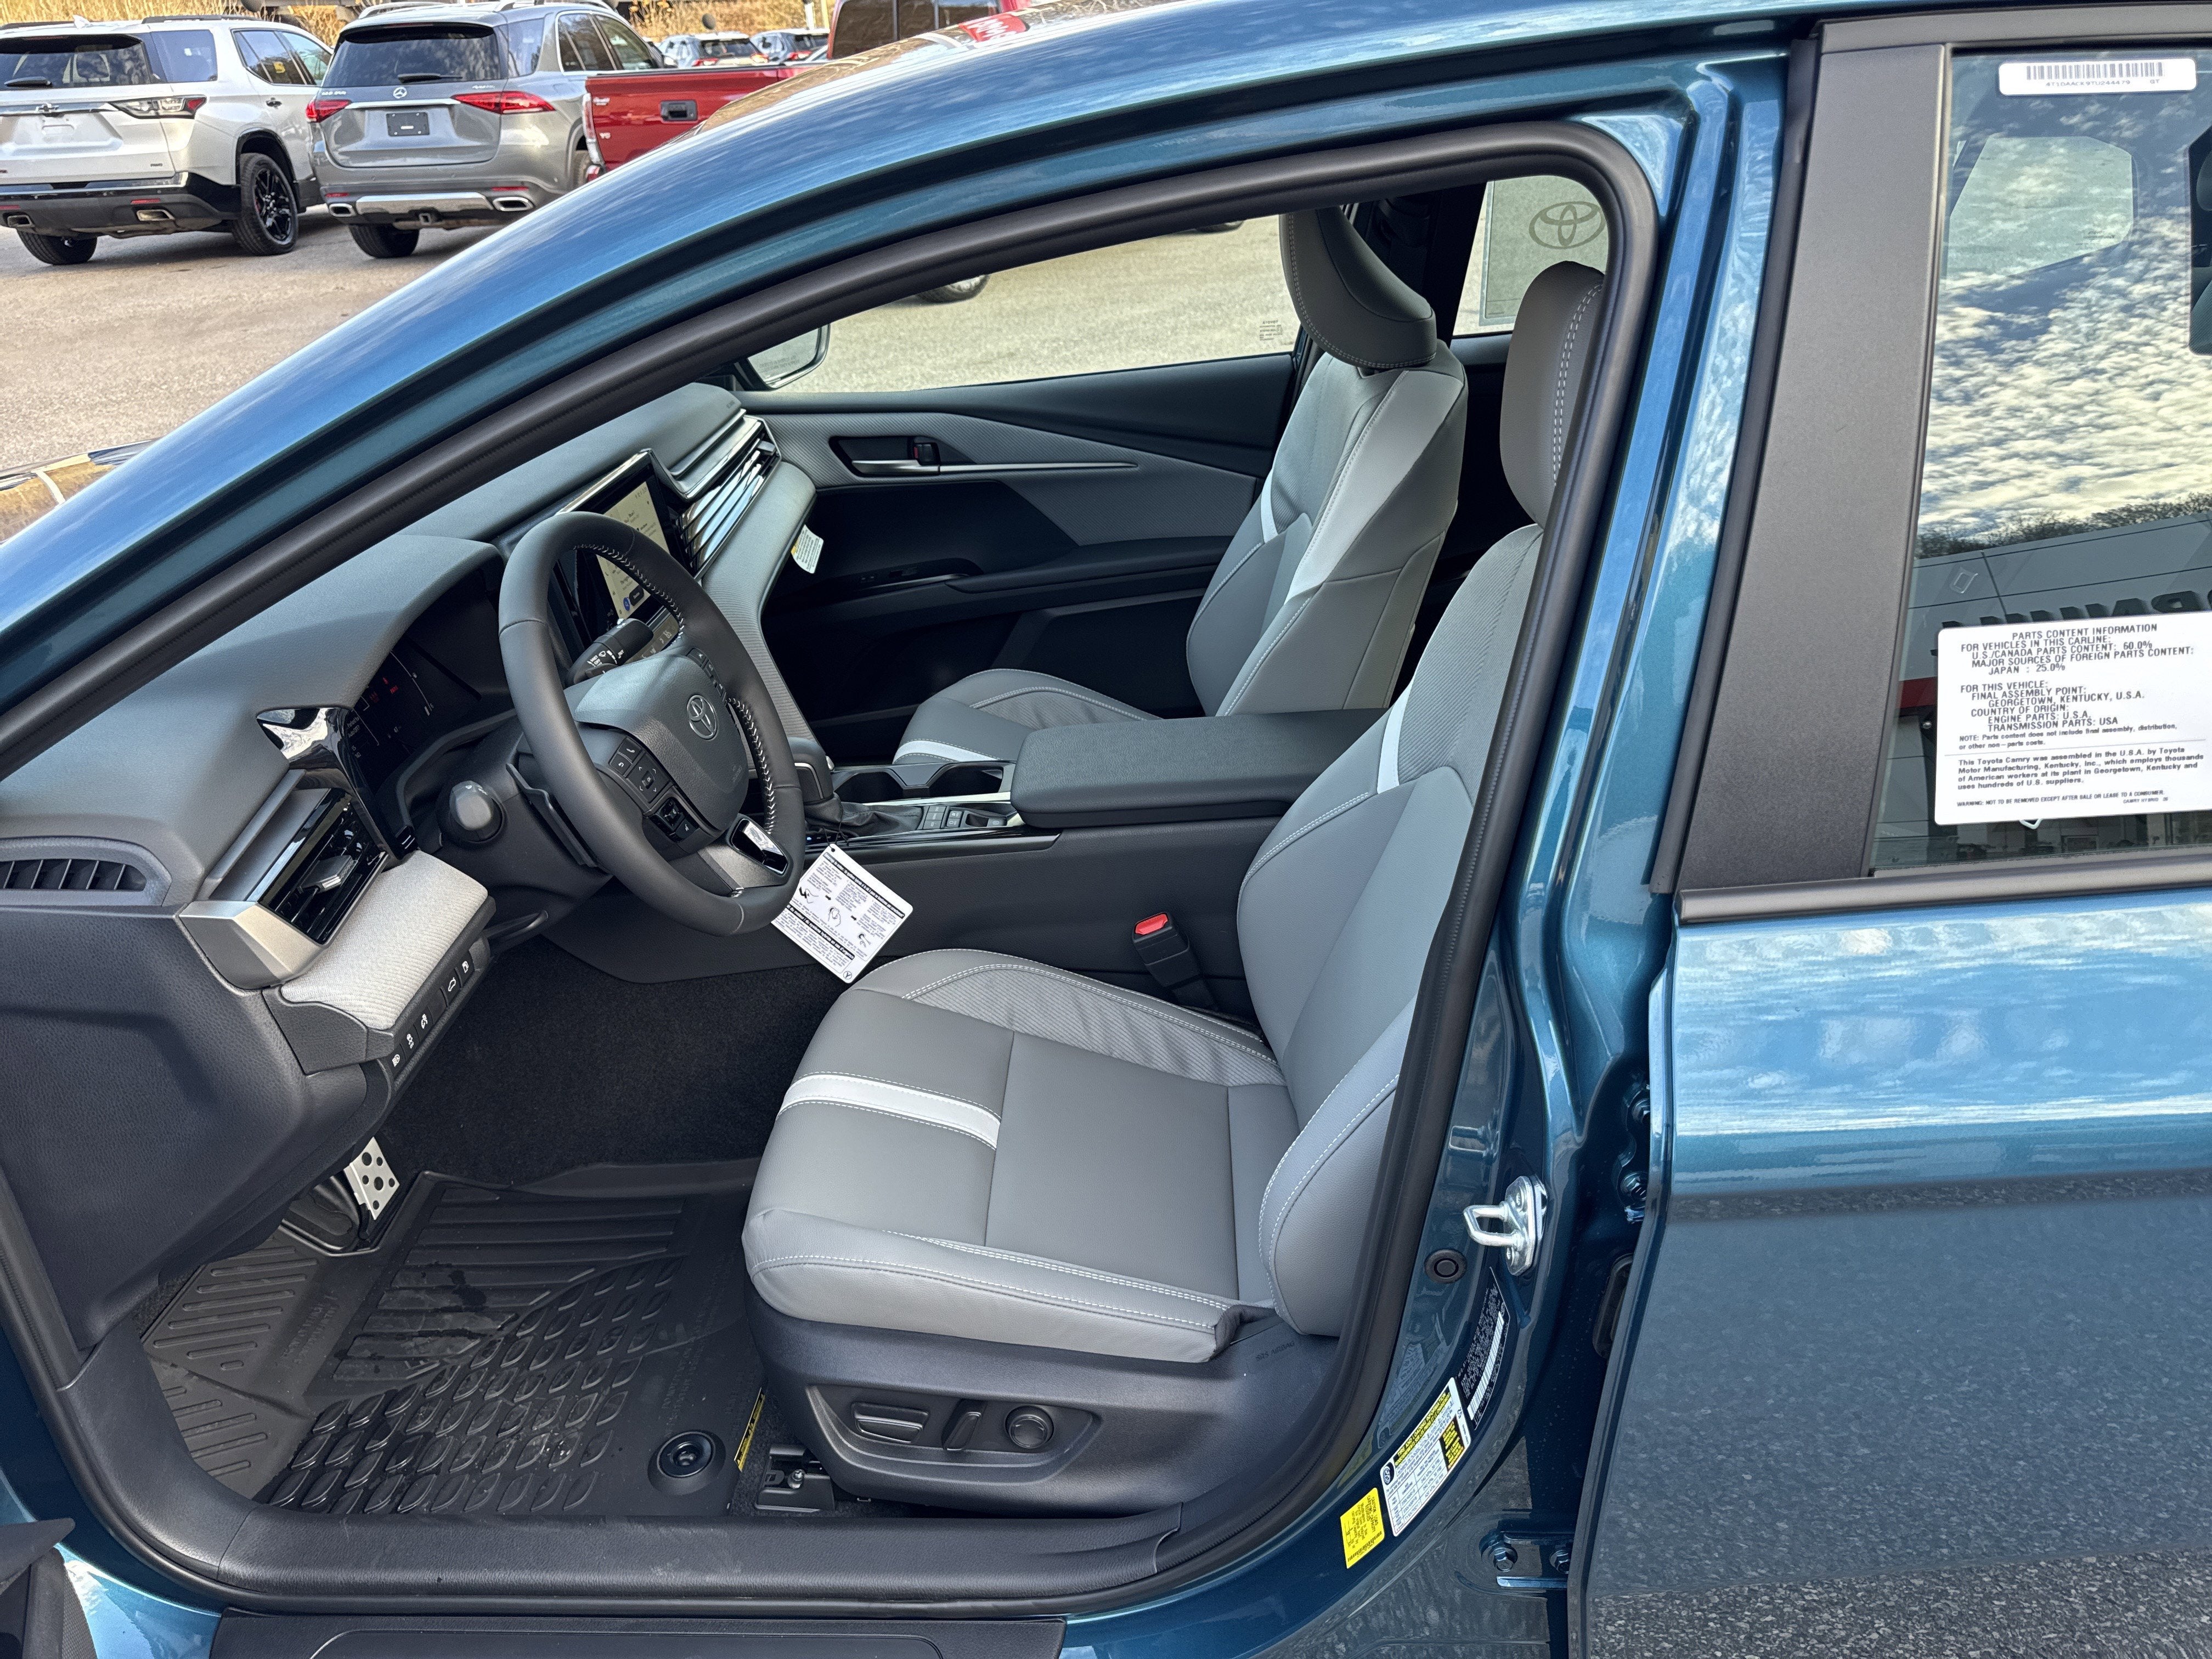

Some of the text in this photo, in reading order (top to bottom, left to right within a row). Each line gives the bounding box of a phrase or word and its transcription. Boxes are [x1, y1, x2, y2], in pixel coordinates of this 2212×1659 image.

[2012, 623, 2157, 641] PARTS CONTENT INFORMATION
[1961, 635, 2111, 652] FOR VEHICLES IN THIS CARLINE:
[1972, 646, 2194, 668] MAJOR SOURCES OF FOREIGN PARTS CONTENT:
[1989, 666, 2019, 676] JAPAN
[2036, 663, 2066, 673] 25.0%
[1960, 680, 2049, 693] FOR THIS VEHICLE:
[1972, 686, 2087, 701] FINAL ASSEMBLY POINT:
[1989, 696, 2057, 709] GEORGETOWN,
[2060, 692, 2113, 704] KENTUCKY,
[1971, 703, 2069, 718] COUNTRY OF ORIGIN:
[1988, 715, 2022, 724] ENGINE
[2026, 713, 2059, 722] PARTS:
[1988, 717, 2118, 732] TRANSMISSION PARTS: USA
[1959, 759, 1974, 768] This
[1978, 757, 2003, 766] Toyota
[2006, 755, 2030, 765] Camry
[2033, 754, 2048, 763] was
[2051, 752, 2092, 762] assembled
[2095, 751, 2102, 759] in
[2105, 750, 2117, 759] the
[2147, 748, 2156, 756] by
[2159, 746, 2185, 755] Toyota
[1968, 774, 2005, 783] American
[2007, 772, 2038, 781] workers
[2062, 769, 2082, 777] plant
[2084, 768, 2091, 776] in
[2094, 765, 2144, 775] Georgetown,
[2147, 763, 2181, 772] Kentucky
[2183, 761, 2198, 770] and
[1978, 781, 2014, 790] hundreds
[2046, 777, 2085, 786] suppliers.
